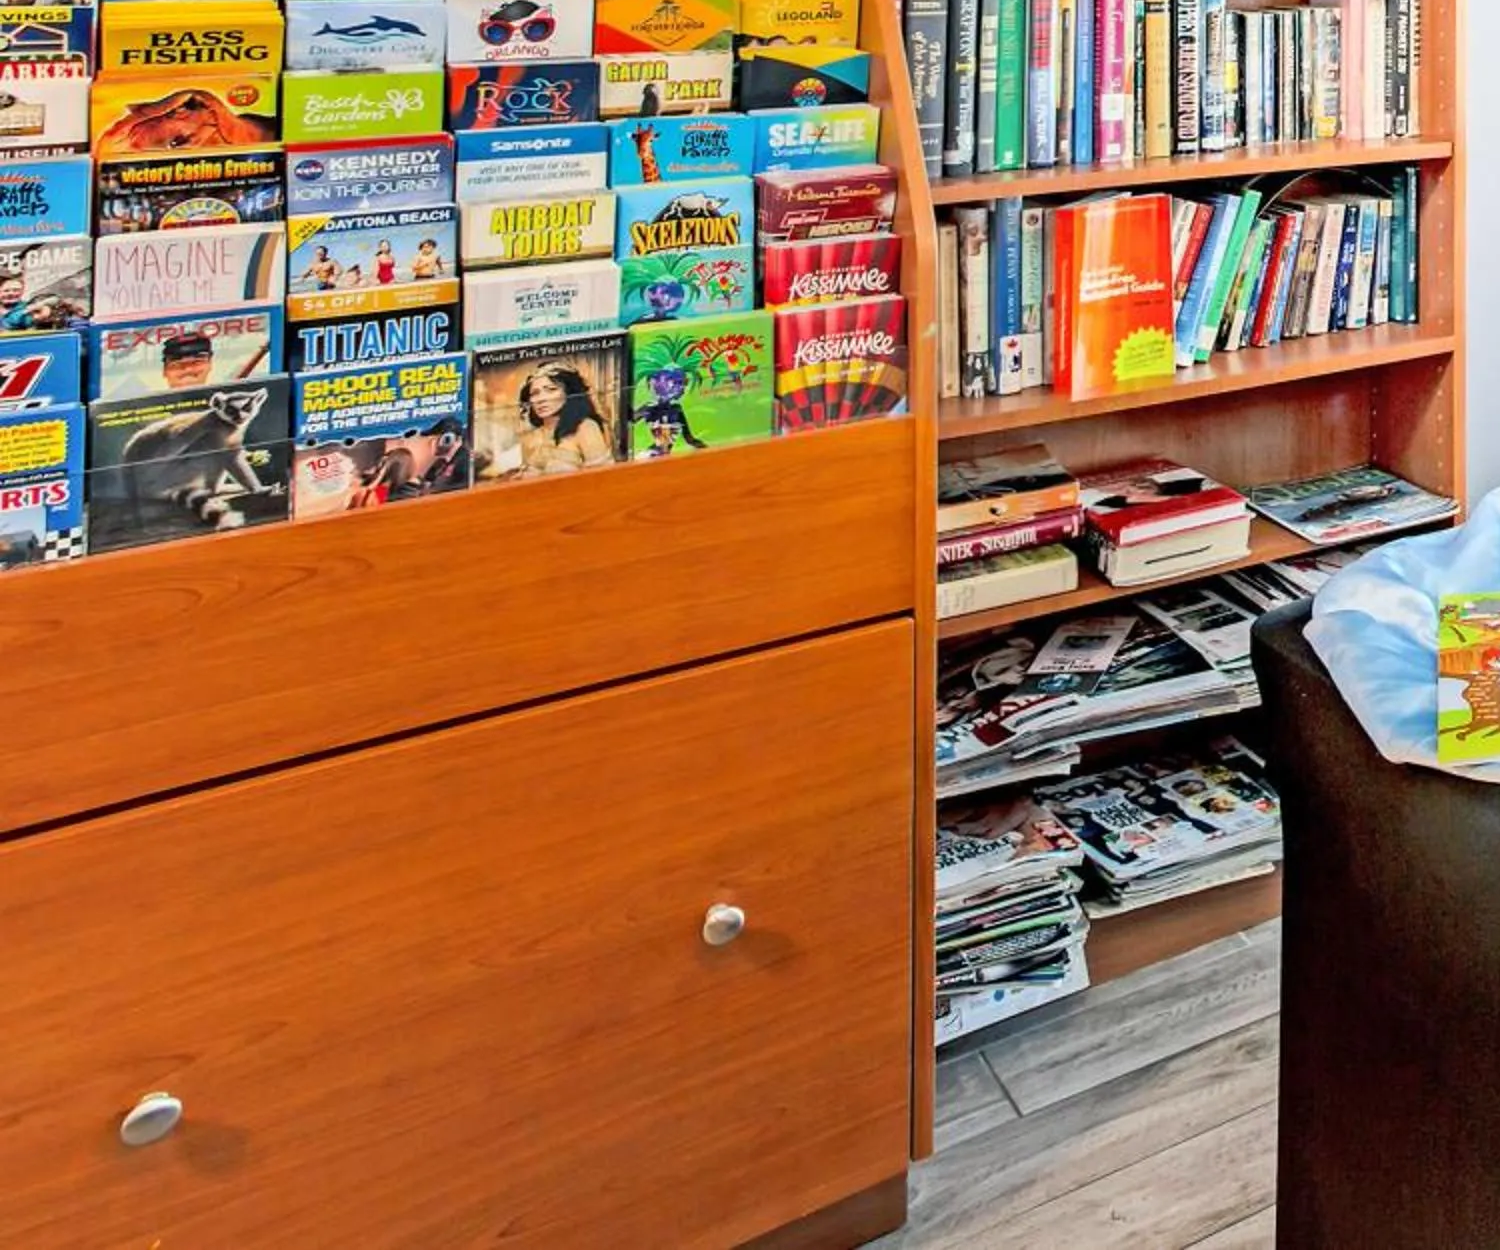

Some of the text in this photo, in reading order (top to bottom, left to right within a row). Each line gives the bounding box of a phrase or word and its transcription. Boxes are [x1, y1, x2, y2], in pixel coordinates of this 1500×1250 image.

[776, 11, 843, 22] LEGOLAND
[149, 29, 245, 48] BASS
[120, 45, 270, 66] FISHING
[928, 40, 942, 62] The
[606, 60, 669, 83] GATOR
[476, 84, 572, 112] ROCK
[664, 78, 722, 101] PARK
[303, 107, 388, 126] Gardens
[490, 137, 573, 152] Samsonite
[120, 158, 275, 185] Victory Casino Cruises
[328, 163, 441, 181] SPACE CENTER
[329, 150, 441, 171] KENNEDY
[293, 184, 331, 200] JOIN
[335, 183, 366, 198] THE
[367, 177, 441, 197] JOURNEY
[324, 209, 451, 232] DAYTONA BEACH
[489, 200, 597, 236] AIRBOAT
[501, 229, 584, 260] TOURS
[630, 212, 742, 256] SKELETONS
[26, 247, 84, 269] GAME
[105, 237, 235, 286] IMAGINE
[789, 267, 891, 301] Kissimmee
[106, 286, 145, 310] YOU
[514, 289, 579, 305] WELCOME
[520, 298, 572, 312] CENTER
[103, 315, 266, 350] EXPLORE
[298, 311, 450, 366] TITANIC
[475, 329, 542, 347] HISTORY
[794, 330, 896, 369] Kissimmee
[303, 370, 393, 400] SHOOT
[399, 362, 463, 386] REAL
[303, 379, 462, 414] MACHINE GUNS!
[301, 401, 463, 435] FOR THE ENTIRE FAMILY!
[330, 399, 417, 421] ADRENALINE
